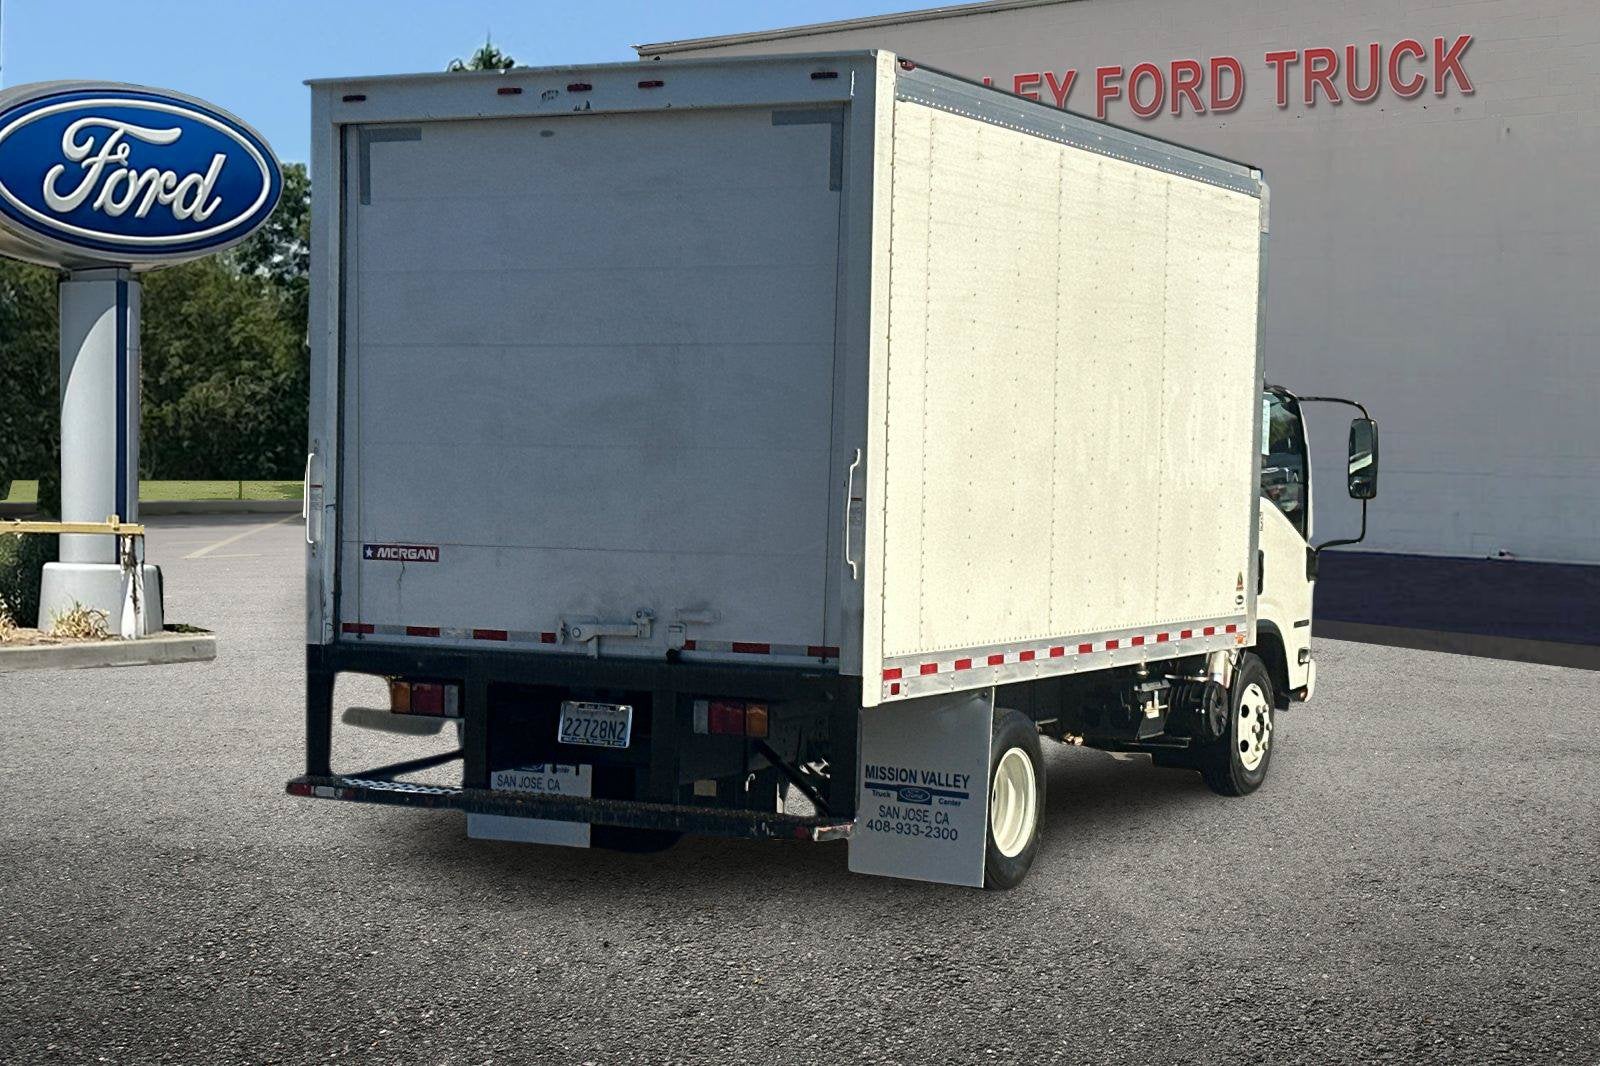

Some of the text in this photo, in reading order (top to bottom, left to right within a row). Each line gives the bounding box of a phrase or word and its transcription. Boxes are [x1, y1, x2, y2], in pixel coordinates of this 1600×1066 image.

[1096, 56, 1243, 118] FORD
[1265, 34, 1474, 107] TRUCK
[43, 117, 226, 222] Ford
[377, 547, 436, 560] MORGAN
[563, 717, 626, 740] 22728N2
[497, 775, 560, 791] SAN JOSE, CA
[865, 764, 970, 789] MISSION VALLEY
[872, 789, 891, 798] Truck
[879, 805, 950, 825] SAN JOSE, CA
[866, 820, 958, 841] 408-933-2300
